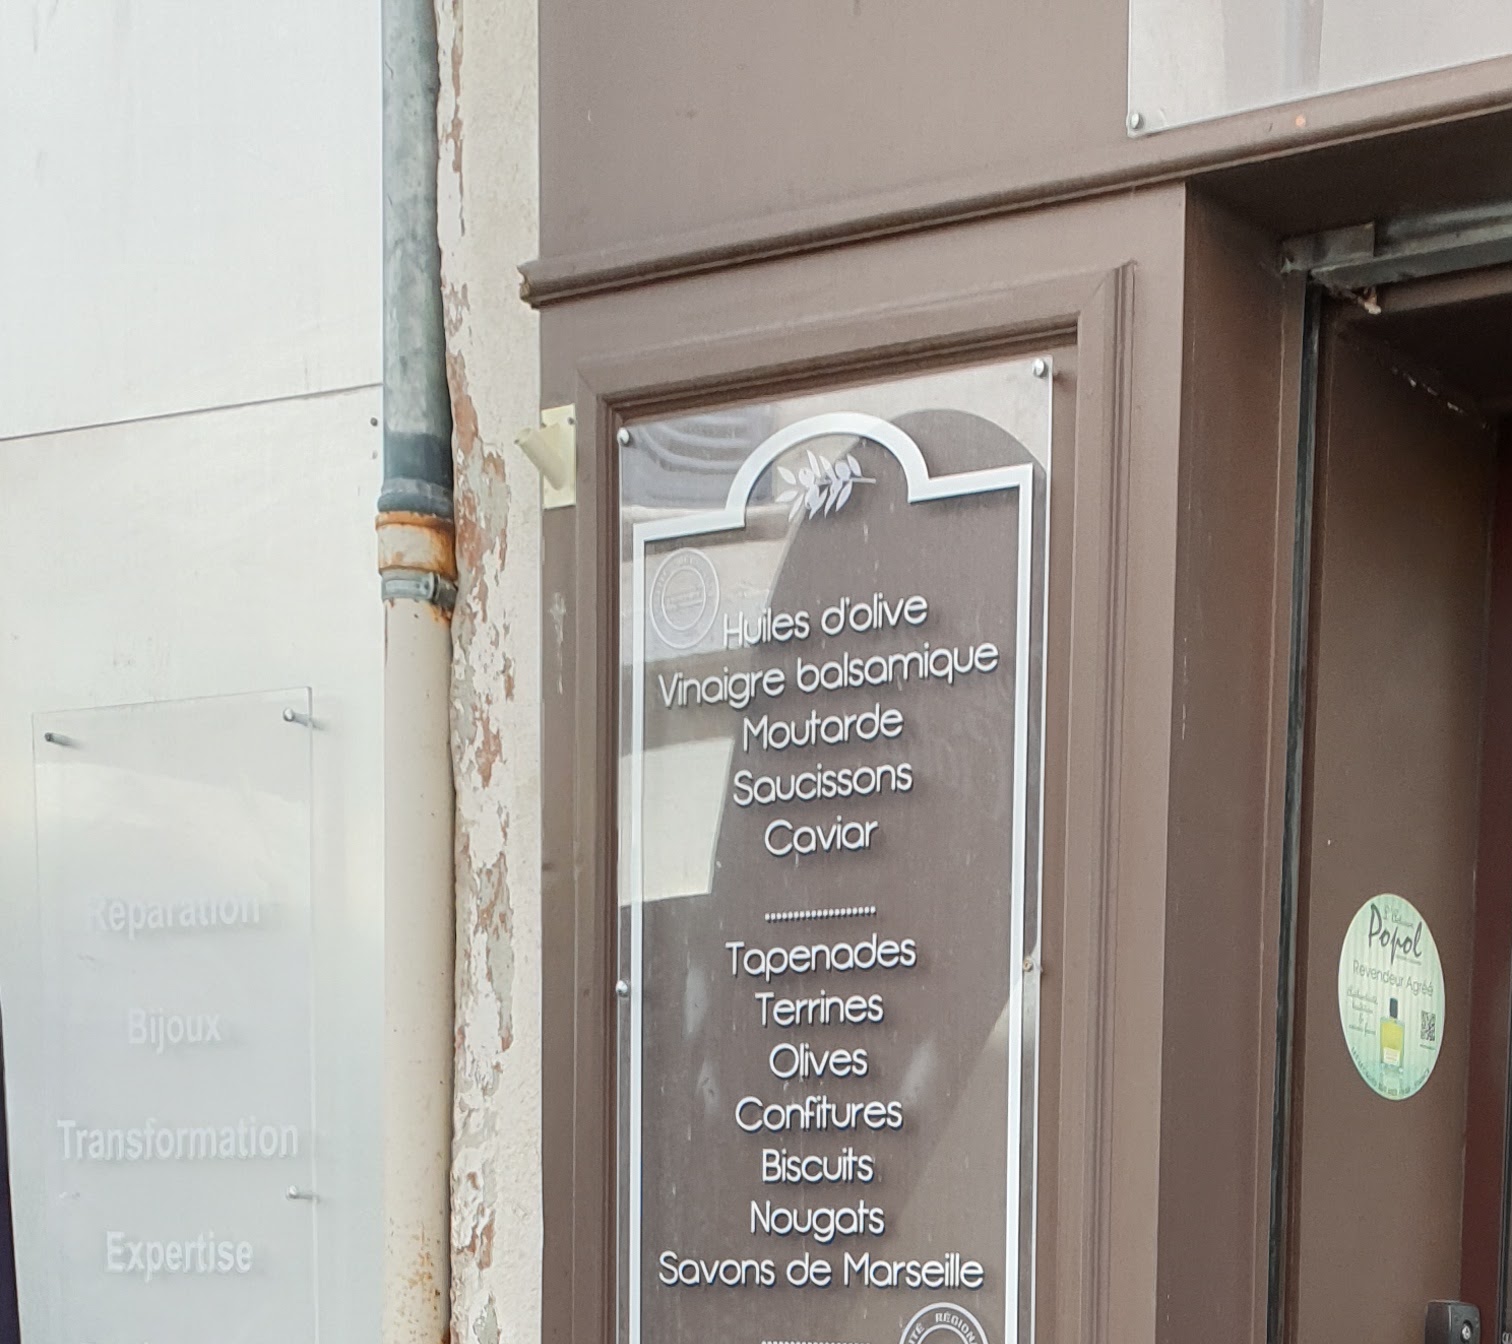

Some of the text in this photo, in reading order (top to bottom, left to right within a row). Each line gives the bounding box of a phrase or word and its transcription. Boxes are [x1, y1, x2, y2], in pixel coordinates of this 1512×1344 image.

[722, 592, 928, 650] Huiles d'olive
[658, 641, 1000, 709] Vinaigre balsamique
[742, 703, 904, 752] Moutarde
[733, 760, 914, 808] Saucissons
[764, 815, 879, 856] Caviar
[724, 932, 917, 982] Tapenades
[1367, 902, 1423, 966] Popol
[1352, 959, 1404, 988] Revendeur
[127, 1006, 223, 1056] Bijoux
[754, 989, 885, 1027] Terrines
[768, 1042, 870, 1080] Olives
[56, 1114, 300, 1162] Transformation
[734, 1095, 904, 1133] Confitures
[761, 1147, 875, 1184] Biscuits
[749, 1198, 886, 1243] Nougats
[104, 1230, 253, 1283] Expertise
[657, 1250, 986, 1290] Savons de Marseille
